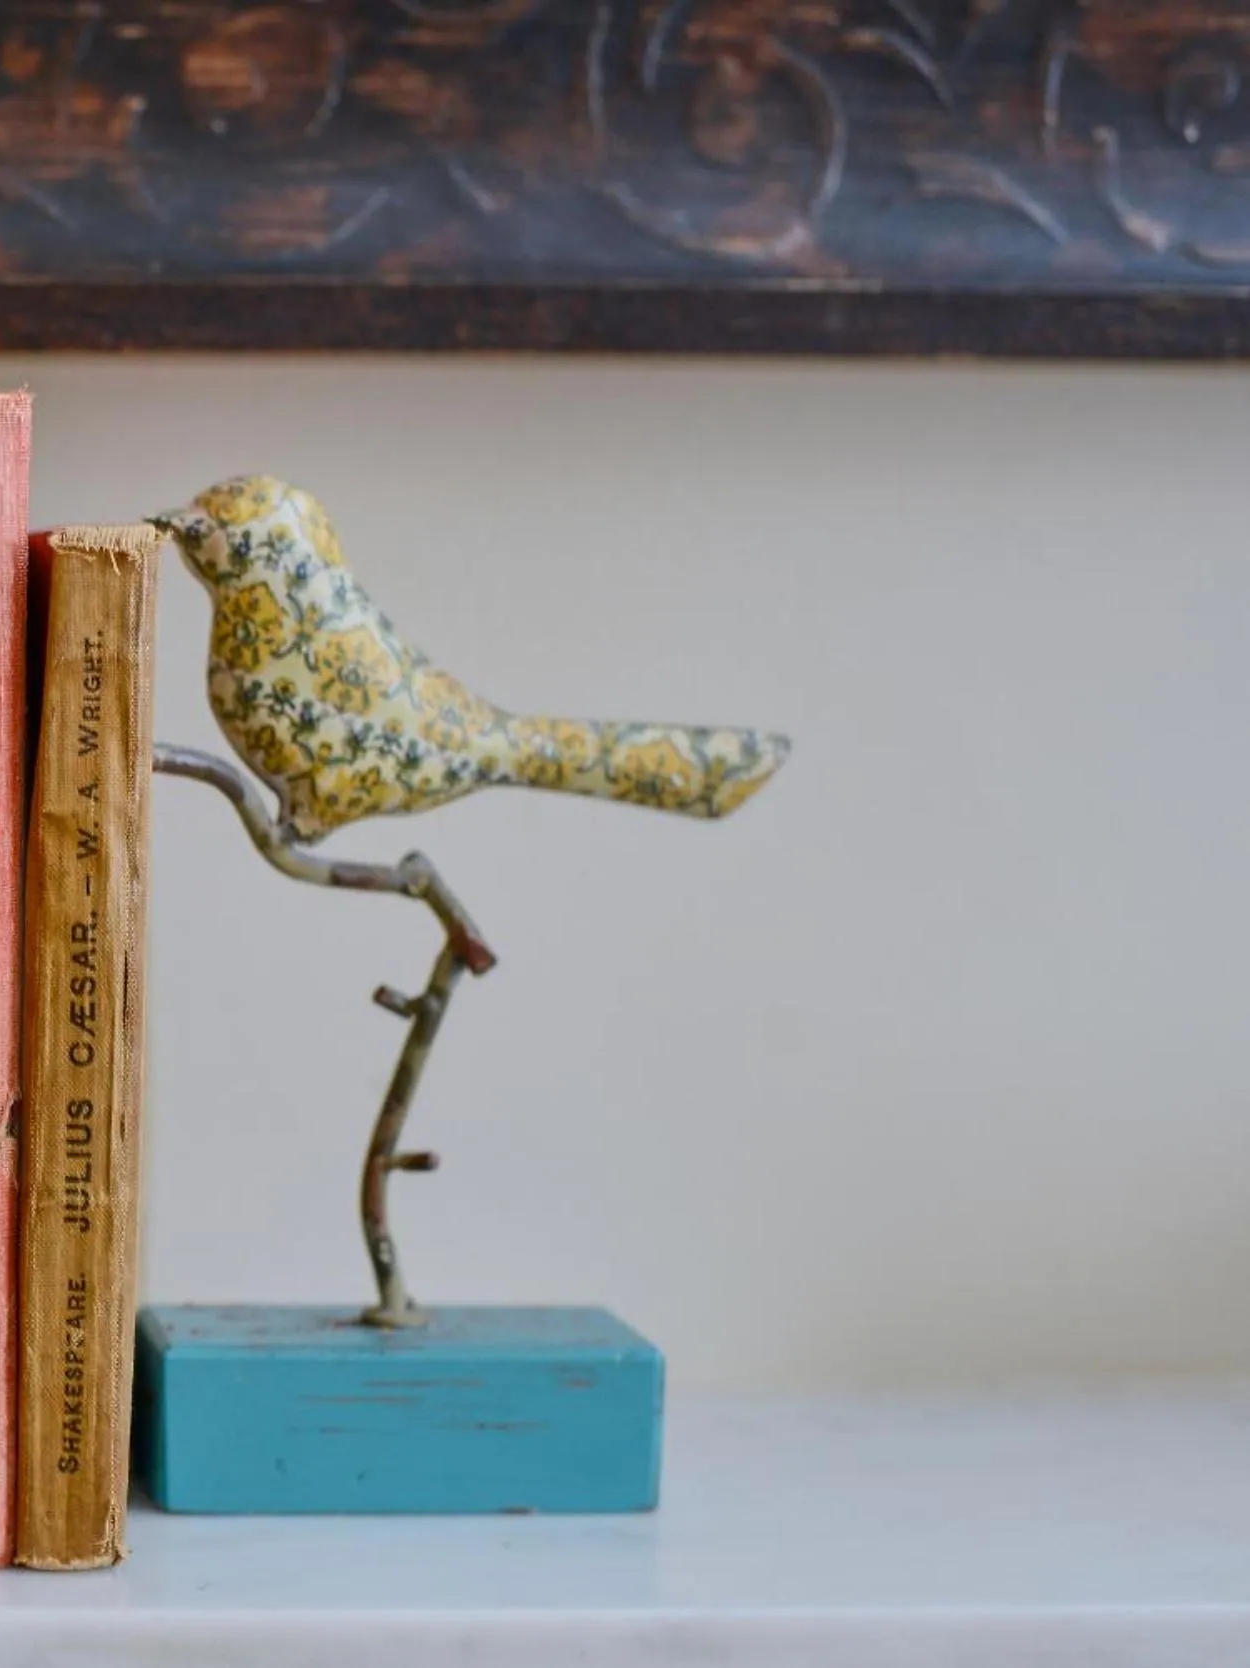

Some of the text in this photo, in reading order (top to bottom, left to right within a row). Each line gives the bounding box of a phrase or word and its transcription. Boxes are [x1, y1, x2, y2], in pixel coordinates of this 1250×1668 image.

[77, 630, 103, 757] WRIGHT.
[77, 821, 100, 861] W.
[68, 910, 97, 1068] CÆSAR.
[63, 1098, 94, 1234] JULIUS
